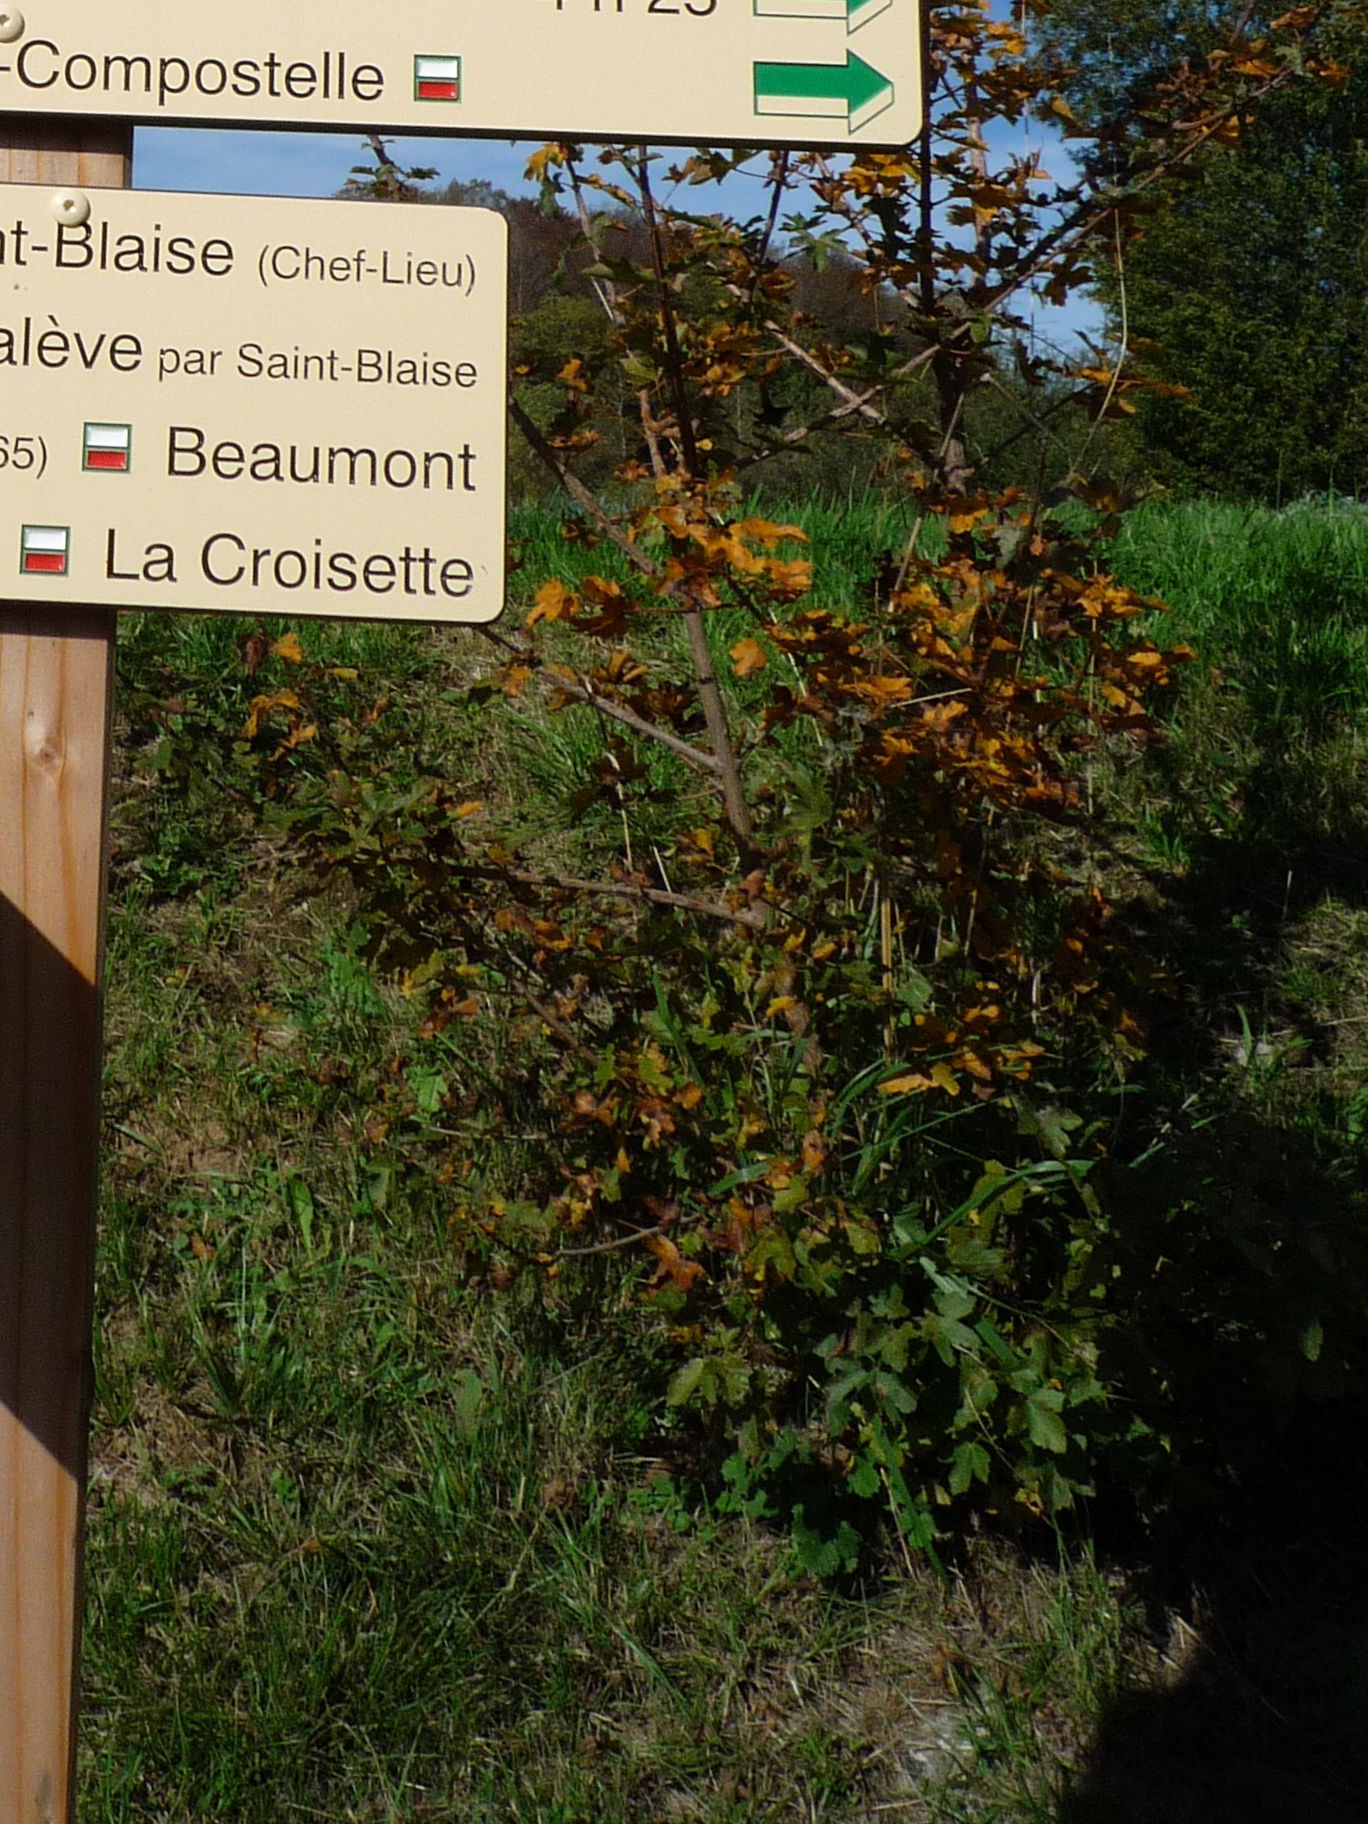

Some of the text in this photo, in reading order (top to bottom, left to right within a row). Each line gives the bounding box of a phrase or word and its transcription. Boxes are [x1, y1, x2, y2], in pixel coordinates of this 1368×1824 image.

[259, 245, 475, 296] (Chef-Lieu)
[159, 348, 222, 382] par
[237, 343, 477, 388] Saint-Blaise
[168, 426, 476, 491] Beaumont
[106, 528, 177, 583] La
[201, 533, 474, 597] Croisette
